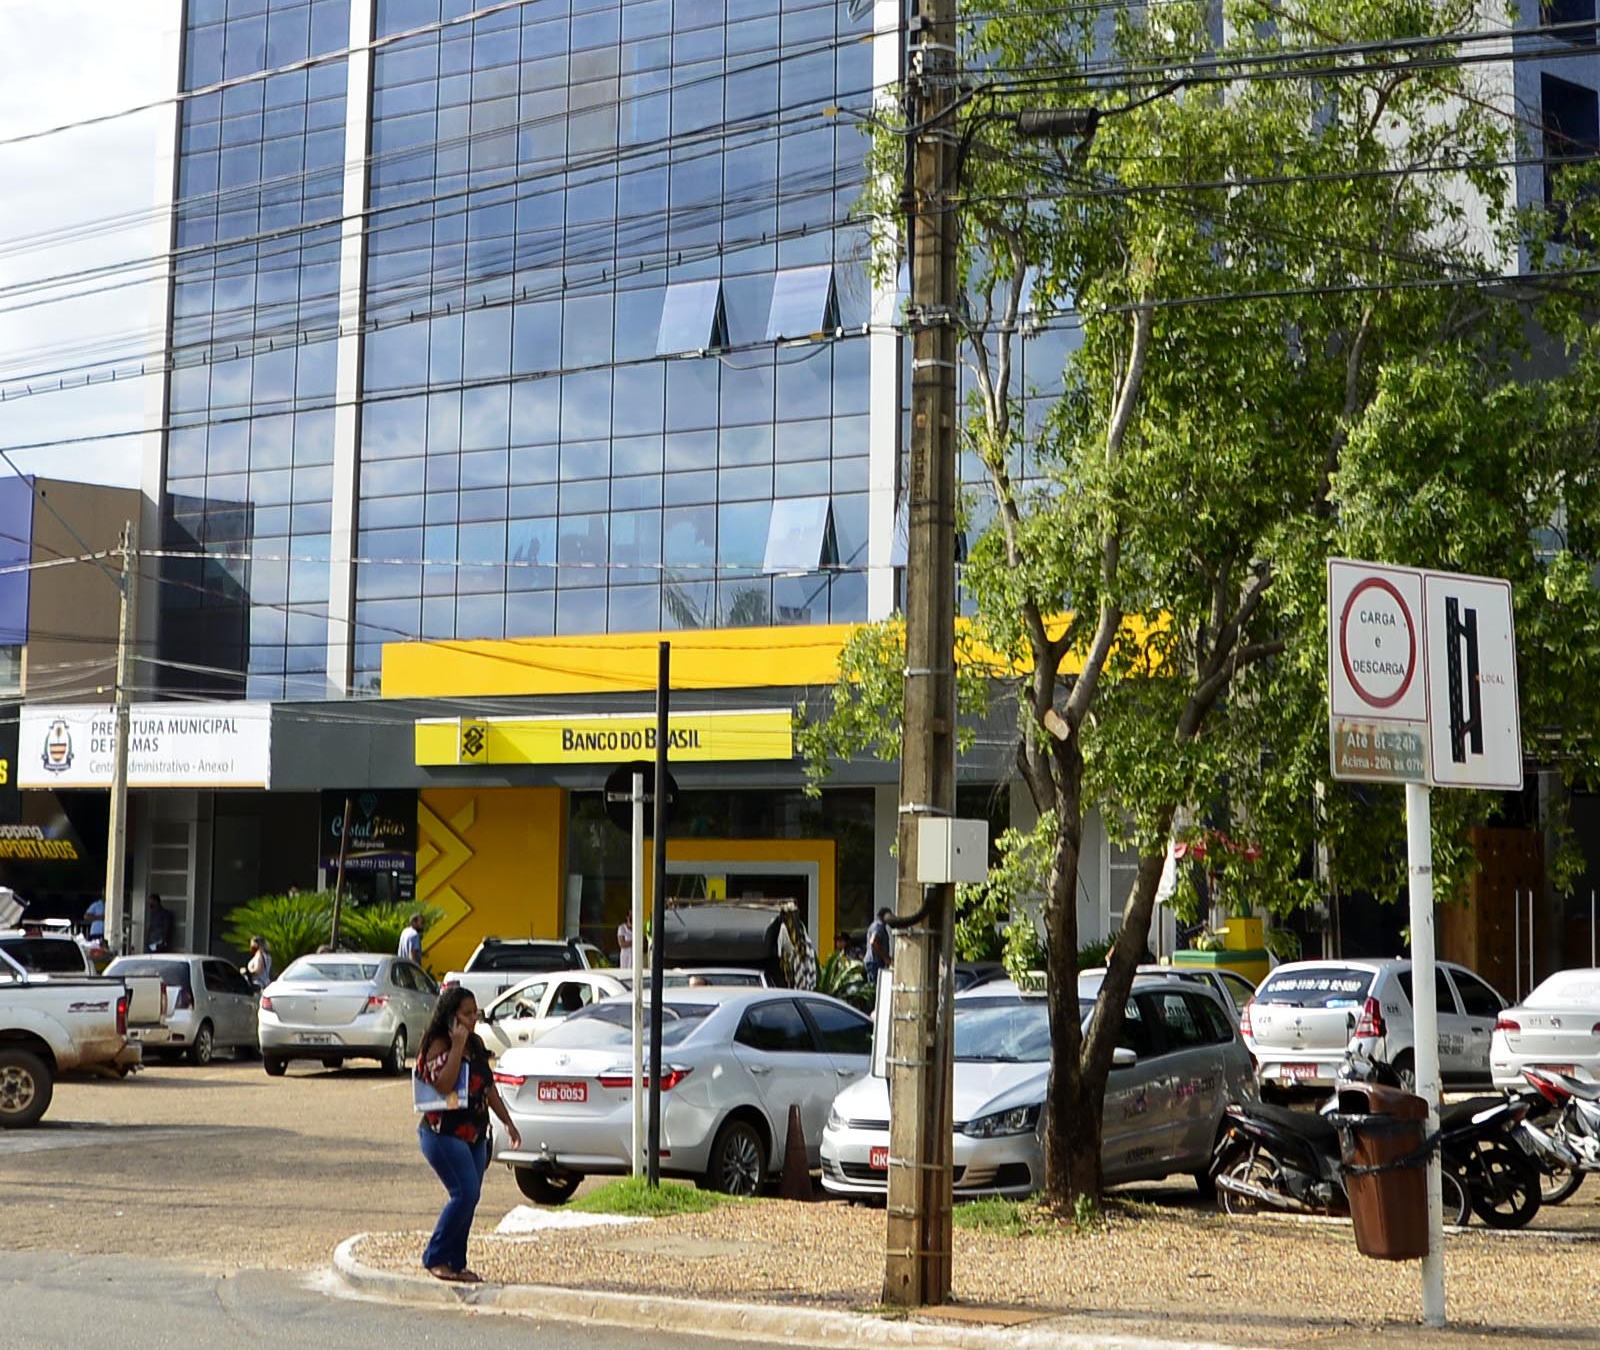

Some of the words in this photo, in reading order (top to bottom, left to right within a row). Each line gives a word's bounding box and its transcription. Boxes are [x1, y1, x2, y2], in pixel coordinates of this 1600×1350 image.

[1360, 610, 1396, 627] CARGA
[1375, 637, 1381, 648] e
[1353, 660, 1405, 676] DESCARGA
[1481, 675, 1505, 685] LOCAL
[91, 719, 164, 736] PRETURA
[168, 717, 238, 734] MUNICIPAL
[91, 738, 106, 753] DE
[562, 728, 617, 751] BANCO
[621, 731, 641, 749] DO
[645, 727, 702, 749] BASIL
[1396, 734, 1416, 751] 24h
[89, 759, 115, 774] Centr
[127, 757, 190, 774] dministrativo
[198, 759, 229, 772] Anexo
